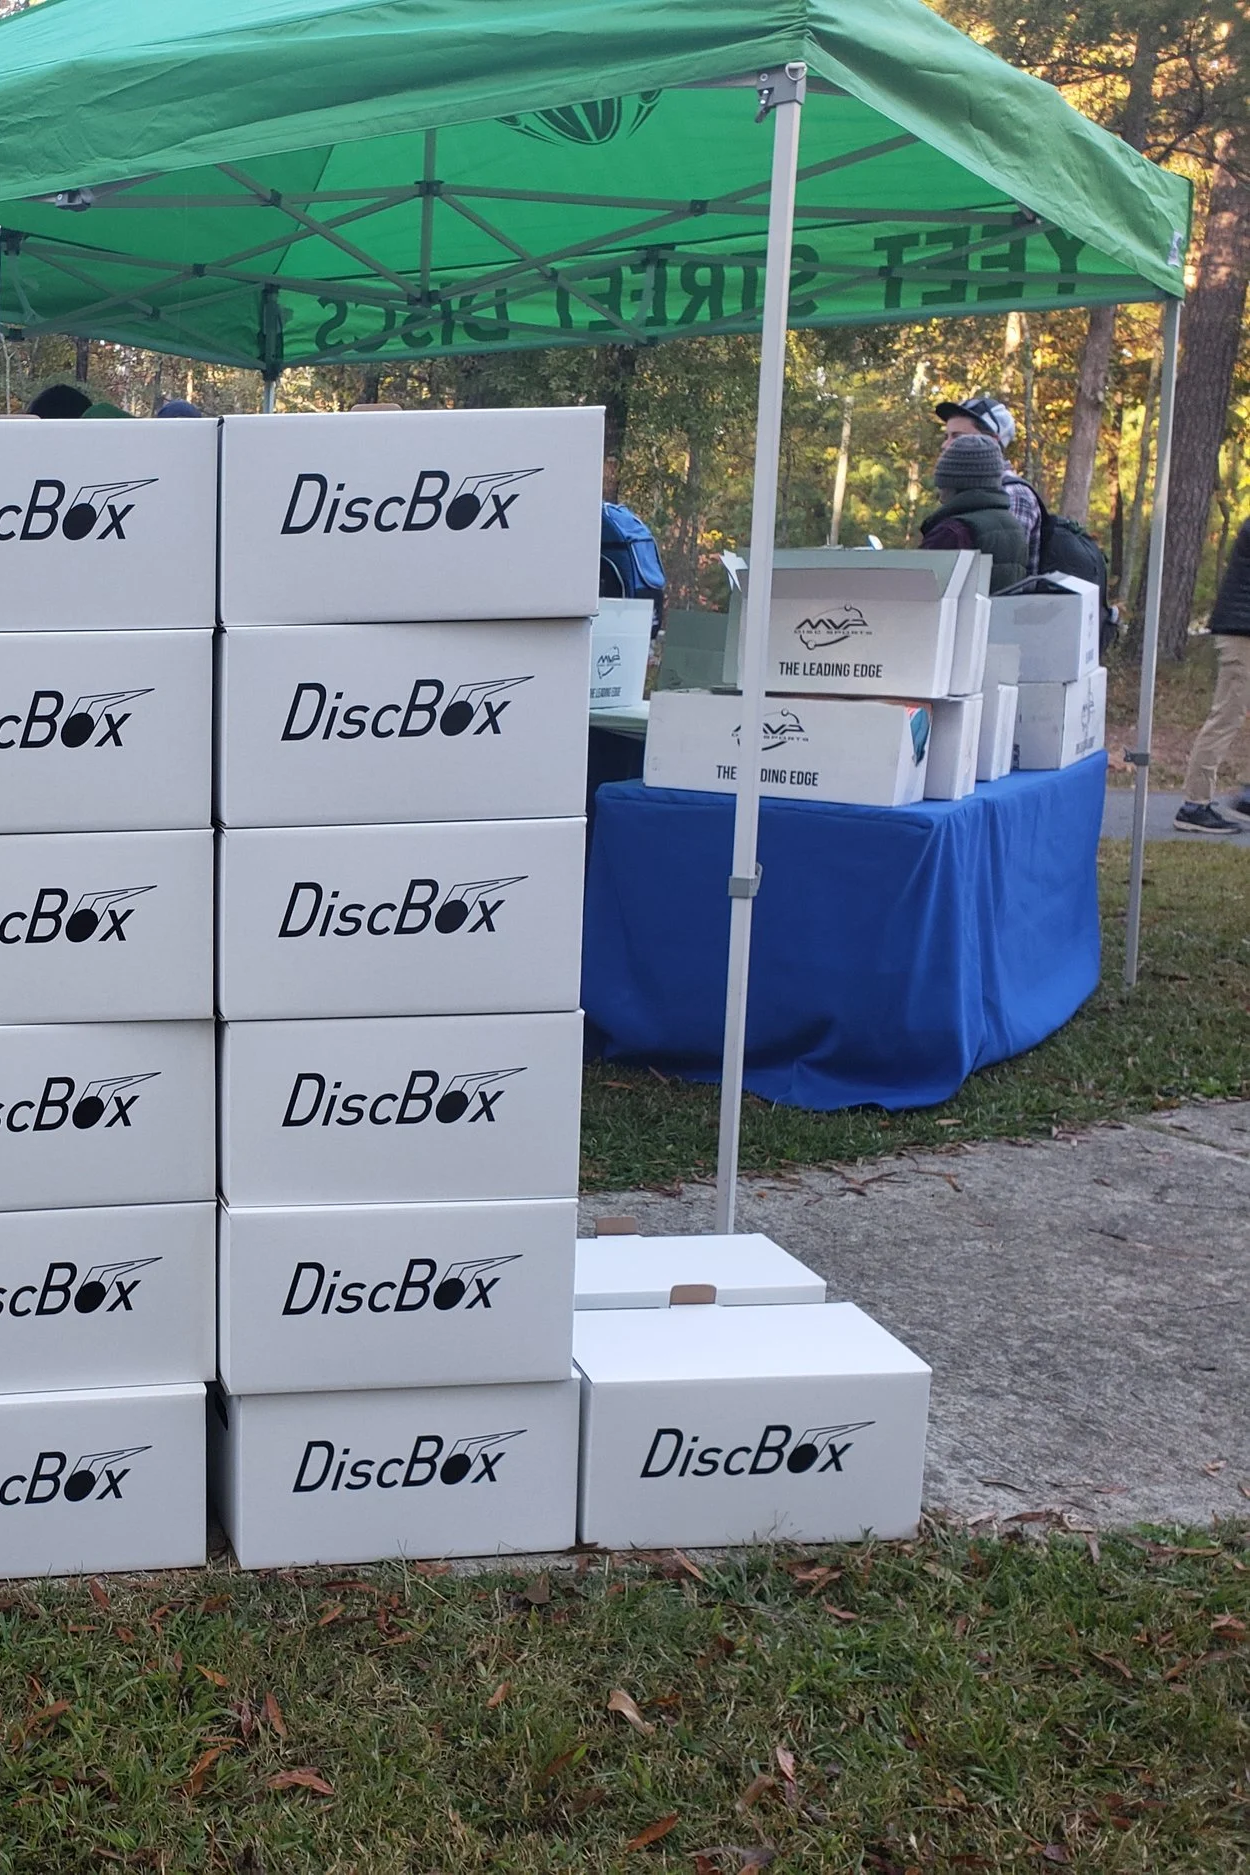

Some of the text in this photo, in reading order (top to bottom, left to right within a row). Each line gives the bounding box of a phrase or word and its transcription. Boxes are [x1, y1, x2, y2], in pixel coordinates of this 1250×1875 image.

[281, 471, 519, 534] DiscBox
[795, 618, 869, 630] MVP
[778, 661, 883, 678] THE LEADING EDGE
[281, 679, 511, 741] DiscBox
[716, 764, 819, 786] THE DING EDGE
[278, 879, 505, 937] DiscBox
[282, 1070, 504, 1126] DiscBox
[282, 1259, 500, 1315] DiscBox
[293, 1435, 505, 1492] DiscBox
[640, 1425, 852, 1478] DiscBox
